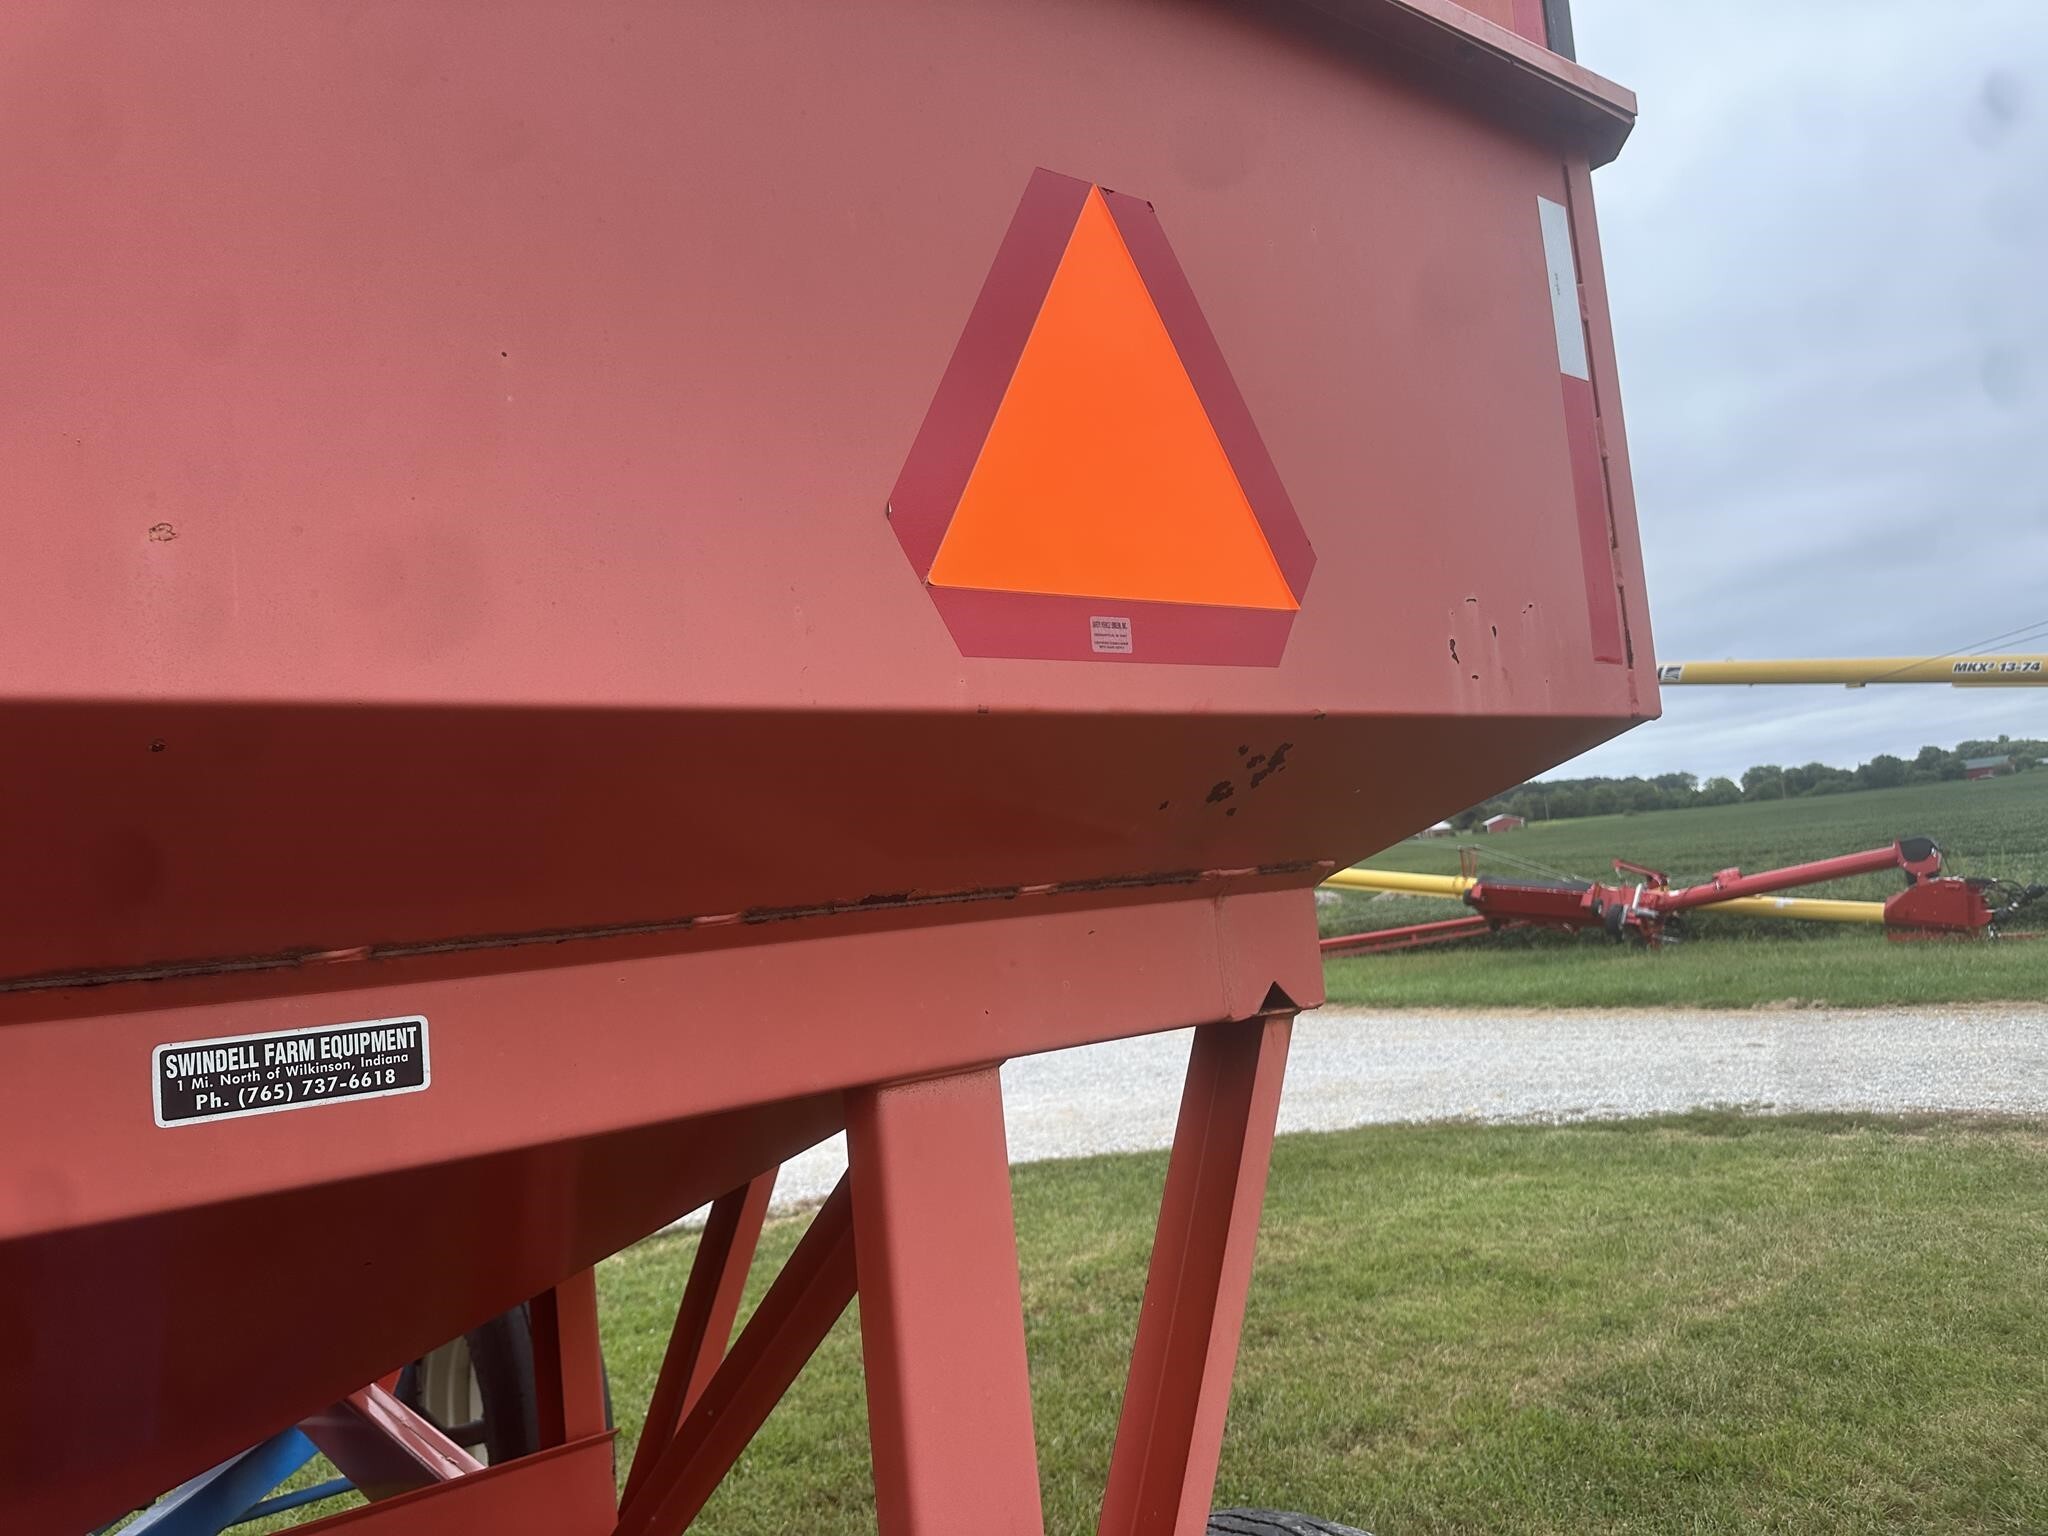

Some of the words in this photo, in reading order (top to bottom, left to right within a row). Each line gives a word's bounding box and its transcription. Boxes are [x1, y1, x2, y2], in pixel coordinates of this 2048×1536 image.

[1999, 662, 2041, 673] 13-74
[165, 1046, 260, 1079] SWINDELL
[264, 1038, 315, 1067] FARM
[320, 1026, 417, 1060] EQUIPMENT
[177, 1080, 183, 1091] 1
[191, 1077, 213, 1090] Mi.
[220, 1070, 261, 1087] North
[266, 1067, 280, 1080] of
[285, 1060, 355, 1077] Wilkinson,
[360, 1053, 409, 1068] Indiana
[195, 1093, 230, 1110] Ph.
[238, 1082, 293, 1109] (765)
[302, 1069, 396, 1096] 737-6618
